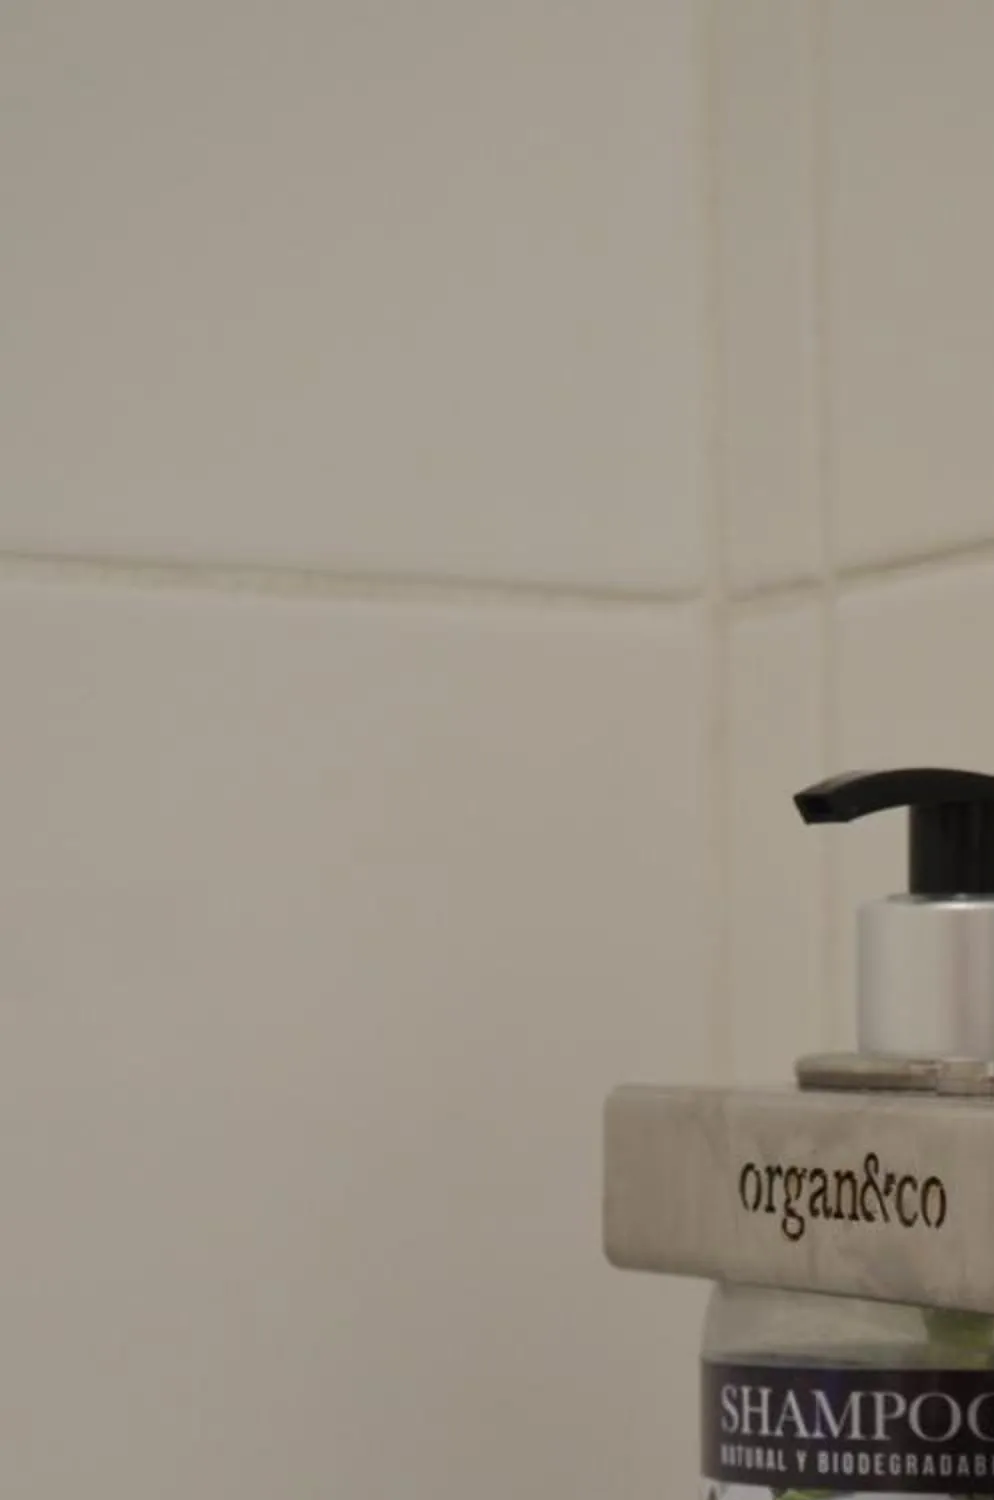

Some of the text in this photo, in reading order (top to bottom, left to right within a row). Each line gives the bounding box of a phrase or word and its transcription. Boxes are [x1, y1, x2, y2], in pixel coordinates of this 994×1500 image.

[738, 1152, 946, 1241] organ&co
[720, 1444, 786, 1472] NATURAL
[796, 1450, 807, 1474] Y
